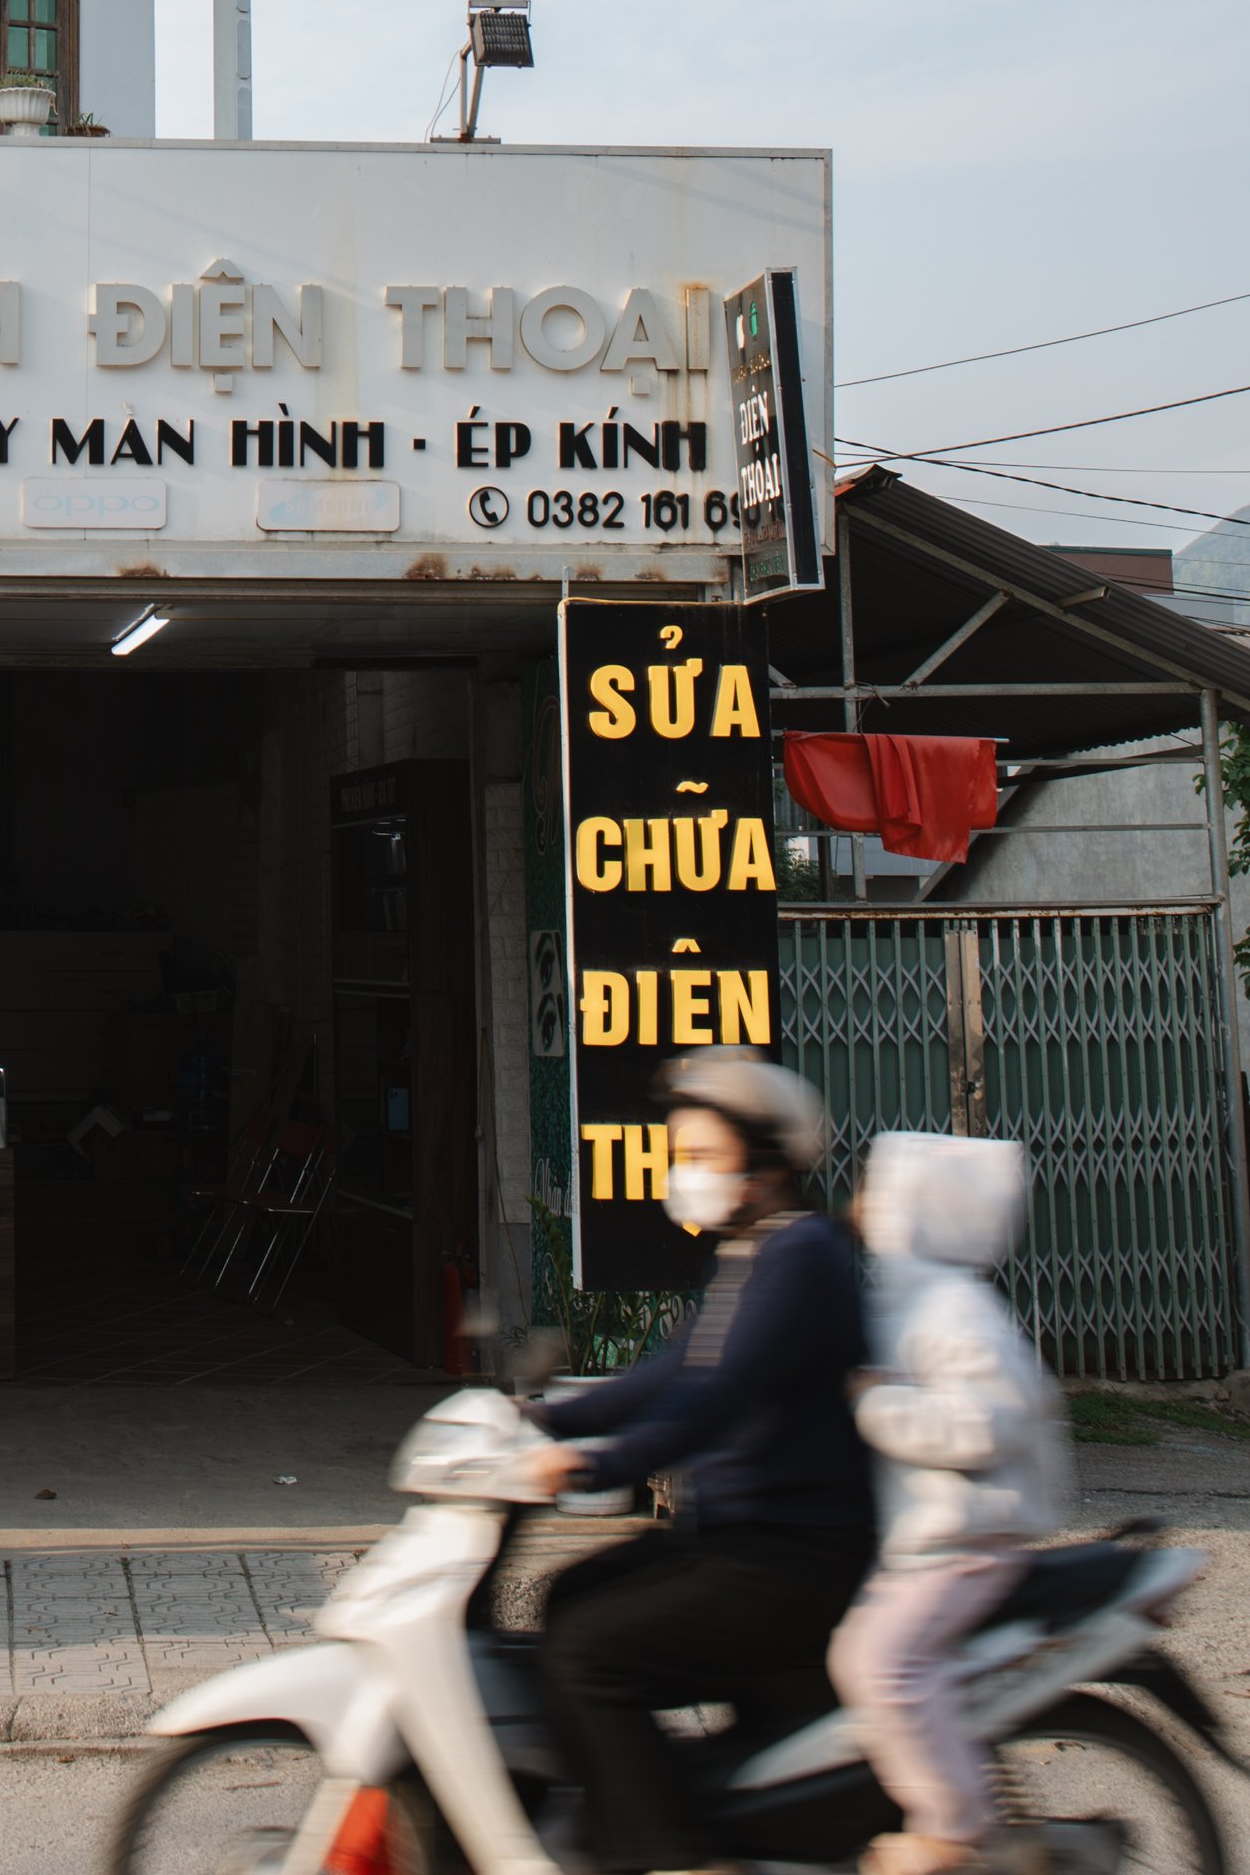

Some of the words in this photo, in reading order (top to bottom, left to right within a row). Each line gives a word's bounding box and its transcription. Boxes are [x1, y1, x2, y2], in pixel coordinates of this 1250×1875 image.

[88, 258, 323, 392] ĐIỆN
[385, 285, 709, 395] THOẠI
[232, 404, 385, 469] HÌNH
[456, 406, 532, 469] ÉP
[559, 406, 707, 471] KÍNH
[739, 385, 771, 452] ĐIỆN
[527, 490, 625, 527] 0382
[641, 490, 689, 529] 161
[741, 452, 781, 512] THOẠI
[588, 625, 761, 739] SỬA
[575, 781, 777, 893] CHỮA
